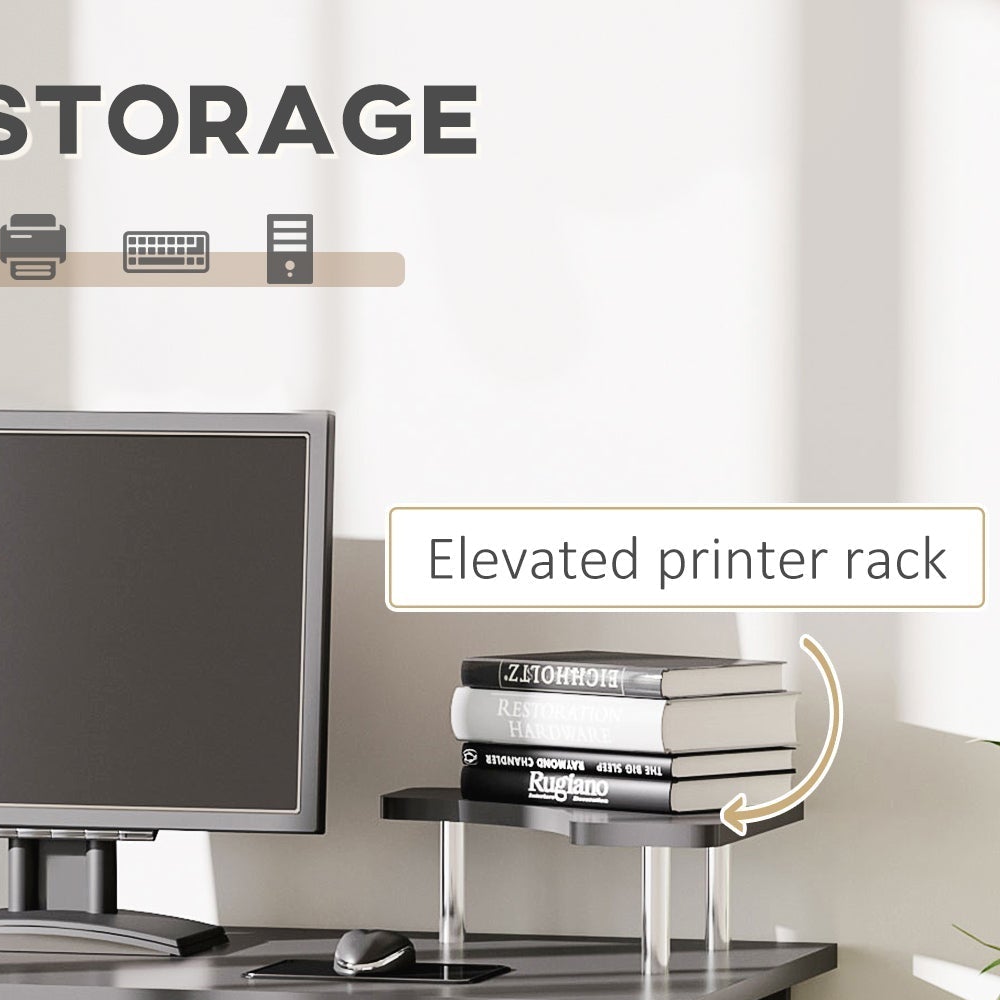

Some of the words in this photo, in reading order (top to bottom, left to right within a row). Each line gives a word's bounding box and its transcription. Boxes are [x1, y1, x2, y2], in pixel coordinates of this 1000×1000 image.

[497, 698, 624, 722] RESTORATION
[509, 720, 612, 743] HARDWARE
[485, 753, 534, 768] CHANDLER
[536, 757, 585, 770] RAYMOND
[596, 761, 623, 773] SLEEP
[625, 763, 642, 774] BIG
[644, 765, 663, 776] THE
[528, 770, 609, 802] Rugiano
